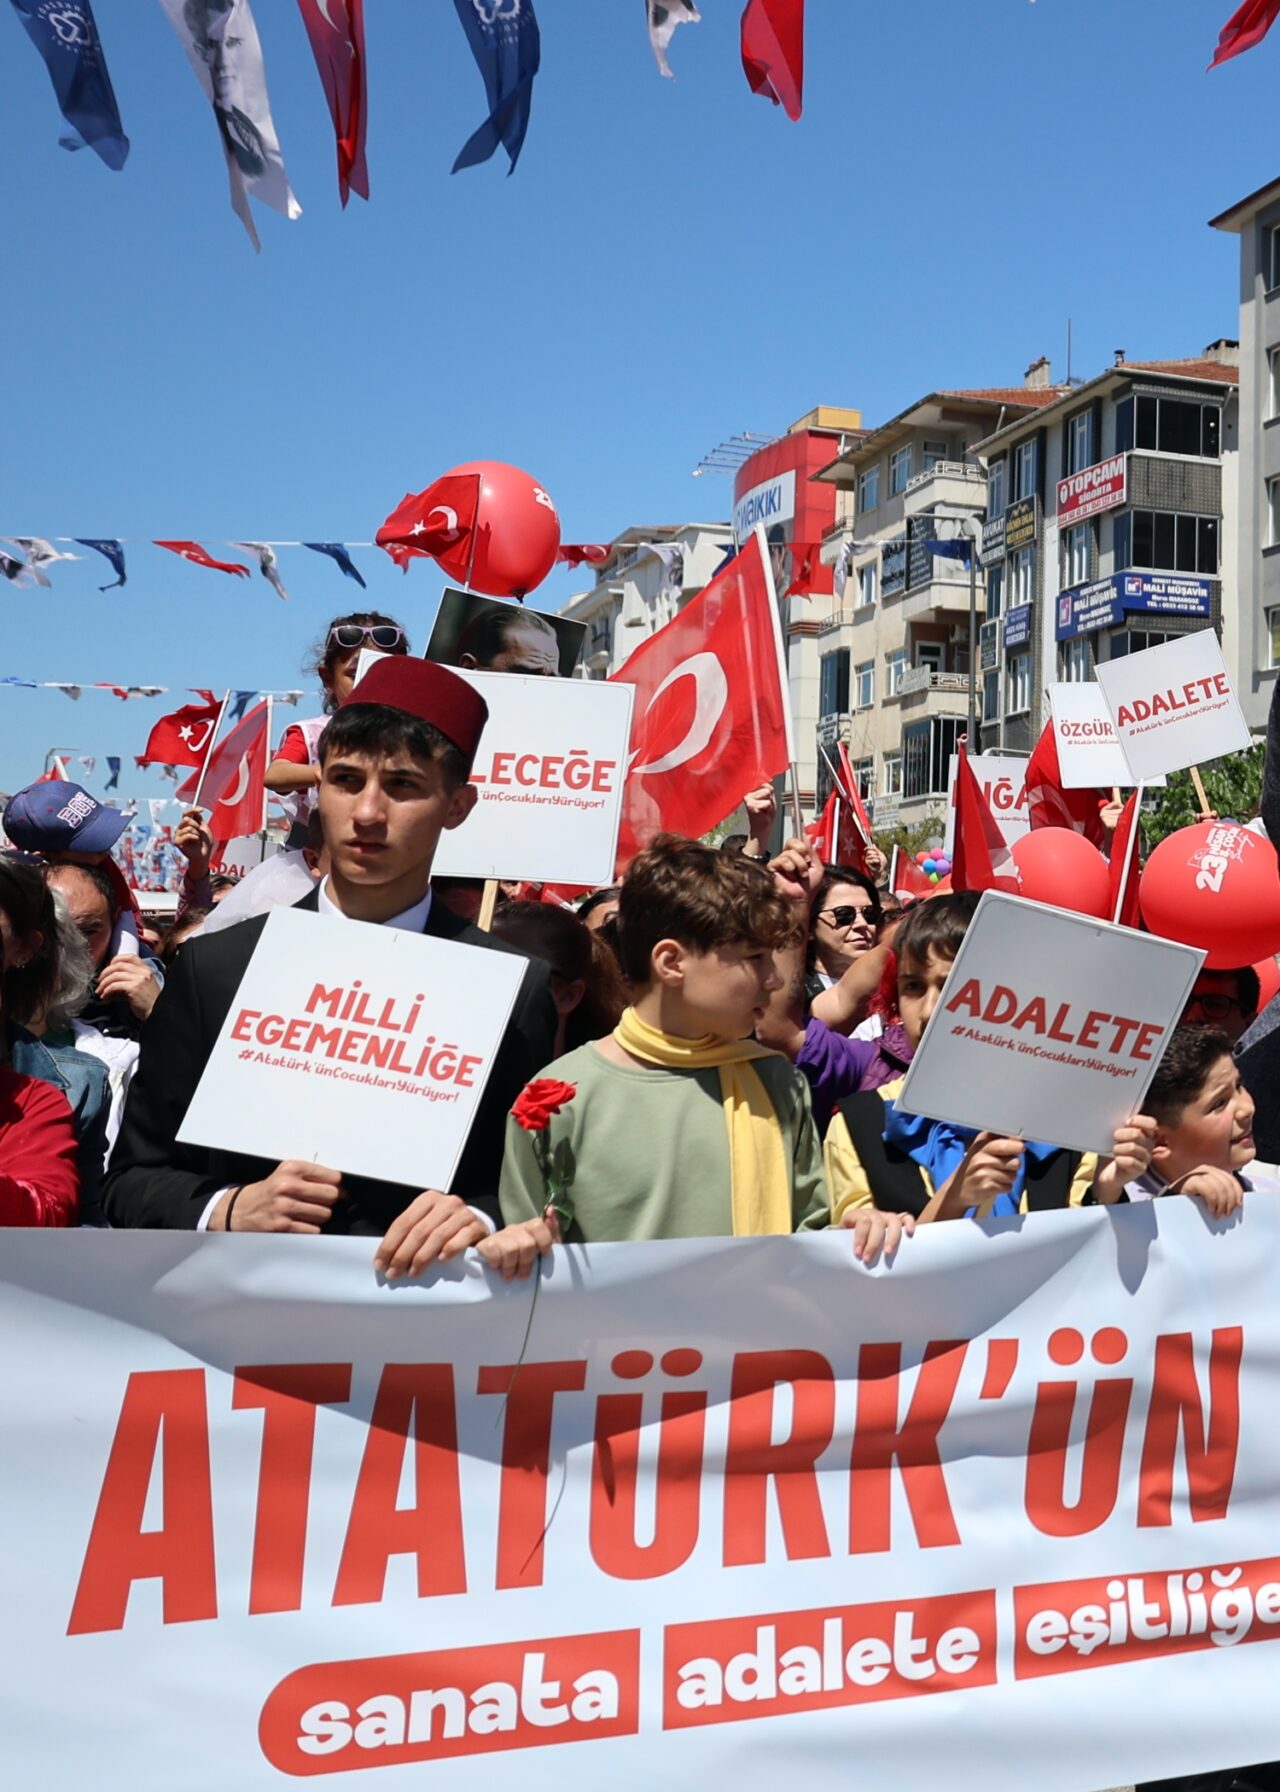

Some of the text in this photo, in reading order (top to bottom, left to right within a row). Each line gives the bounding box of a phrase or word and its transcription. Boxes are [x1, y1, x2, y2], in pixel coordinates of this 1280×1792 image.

[1068, 457, 1124, 497] TOPÇAM
[1078, 483, 1112, 504] SİGORTA
[1143, 583, 1208, 598] MALİ MÜŞAVİR
[1117, 672, 1230, 727] ADALETE
[1060, 718, 1114, 737] ÖZGÜR
[1196, 855, 1228, 893] 23
[304, 979, 426, 1034] MİLLİ
[945, 978, 1165, 1061] ADALETE
[230, 1008, 483, 1088] EGEMENLİĞE
[66, 1326, 1244, 1635] ATATÜRK'ÜN
[297, 1652, 620, 1756] sanata
[676, 1611, 980, 1709] adalete
